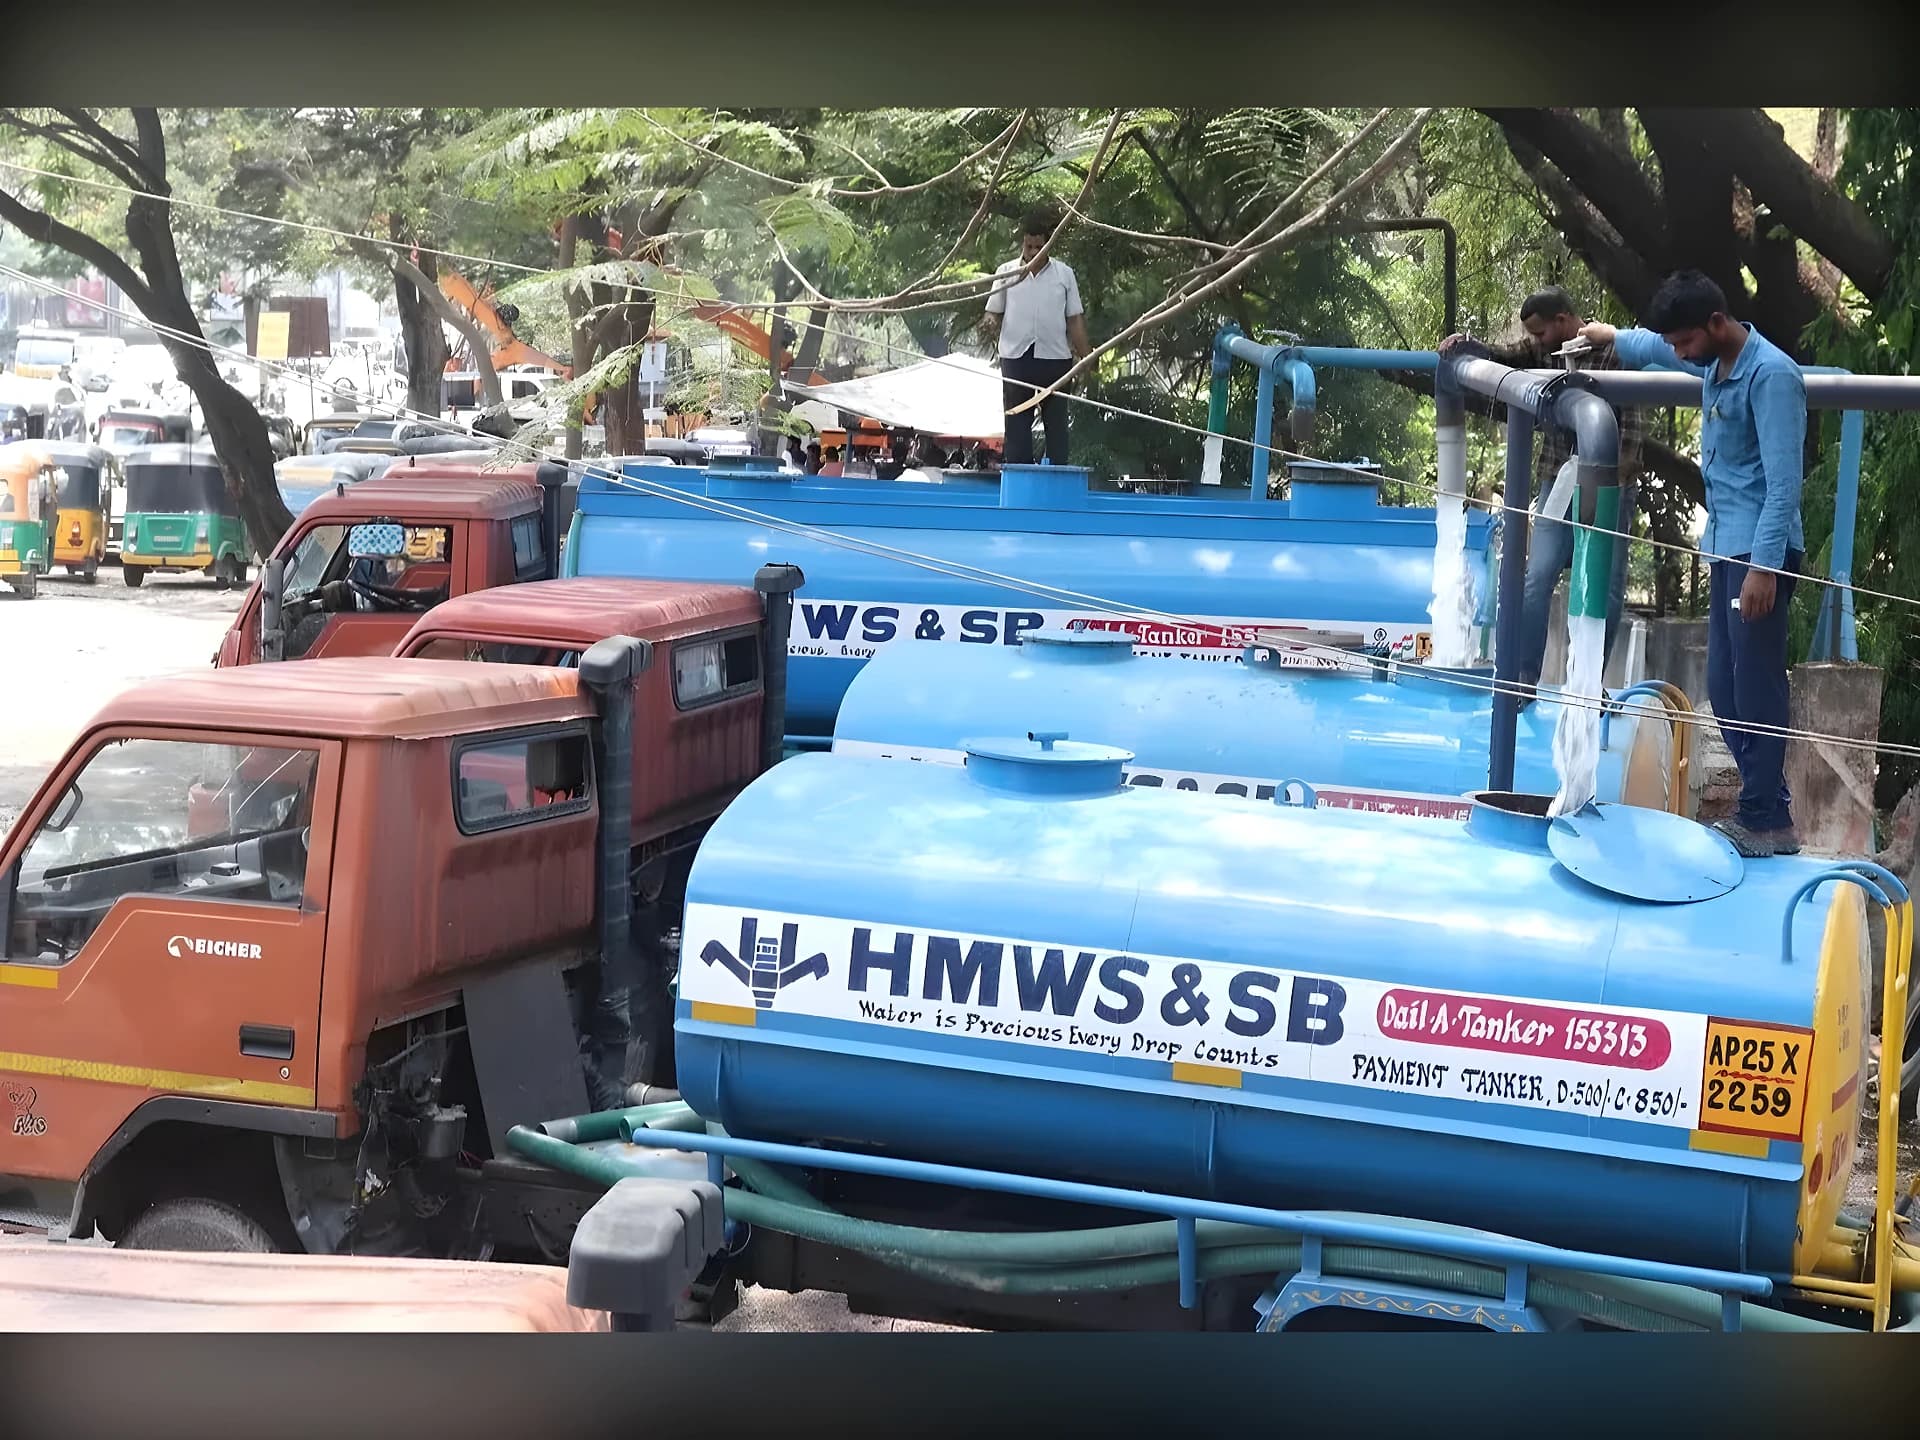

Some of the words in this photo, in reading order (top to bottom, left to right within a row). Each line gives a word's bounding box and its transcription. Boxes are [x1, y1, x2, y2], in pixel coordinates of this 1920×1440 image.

[915, 609, 945, 641] &
[195, 938, 262, 959] EICHER
[859, 1000, 922, 1023] Water
[936, 1009, 957, 1027] is
[965, 1013, 1063, 1042] Precious
[1069, 1026, 1121, 1054] Every
[1132, 1032, 1182, 1060] Drop
[1194, 1040, 1279, 1067] Counts
[1564, 1017, 1648, 1057] 155313
[1352, 1054, 1449, 1089] PAYMENT
[1707, 1078, 1791, 1118] 2259
